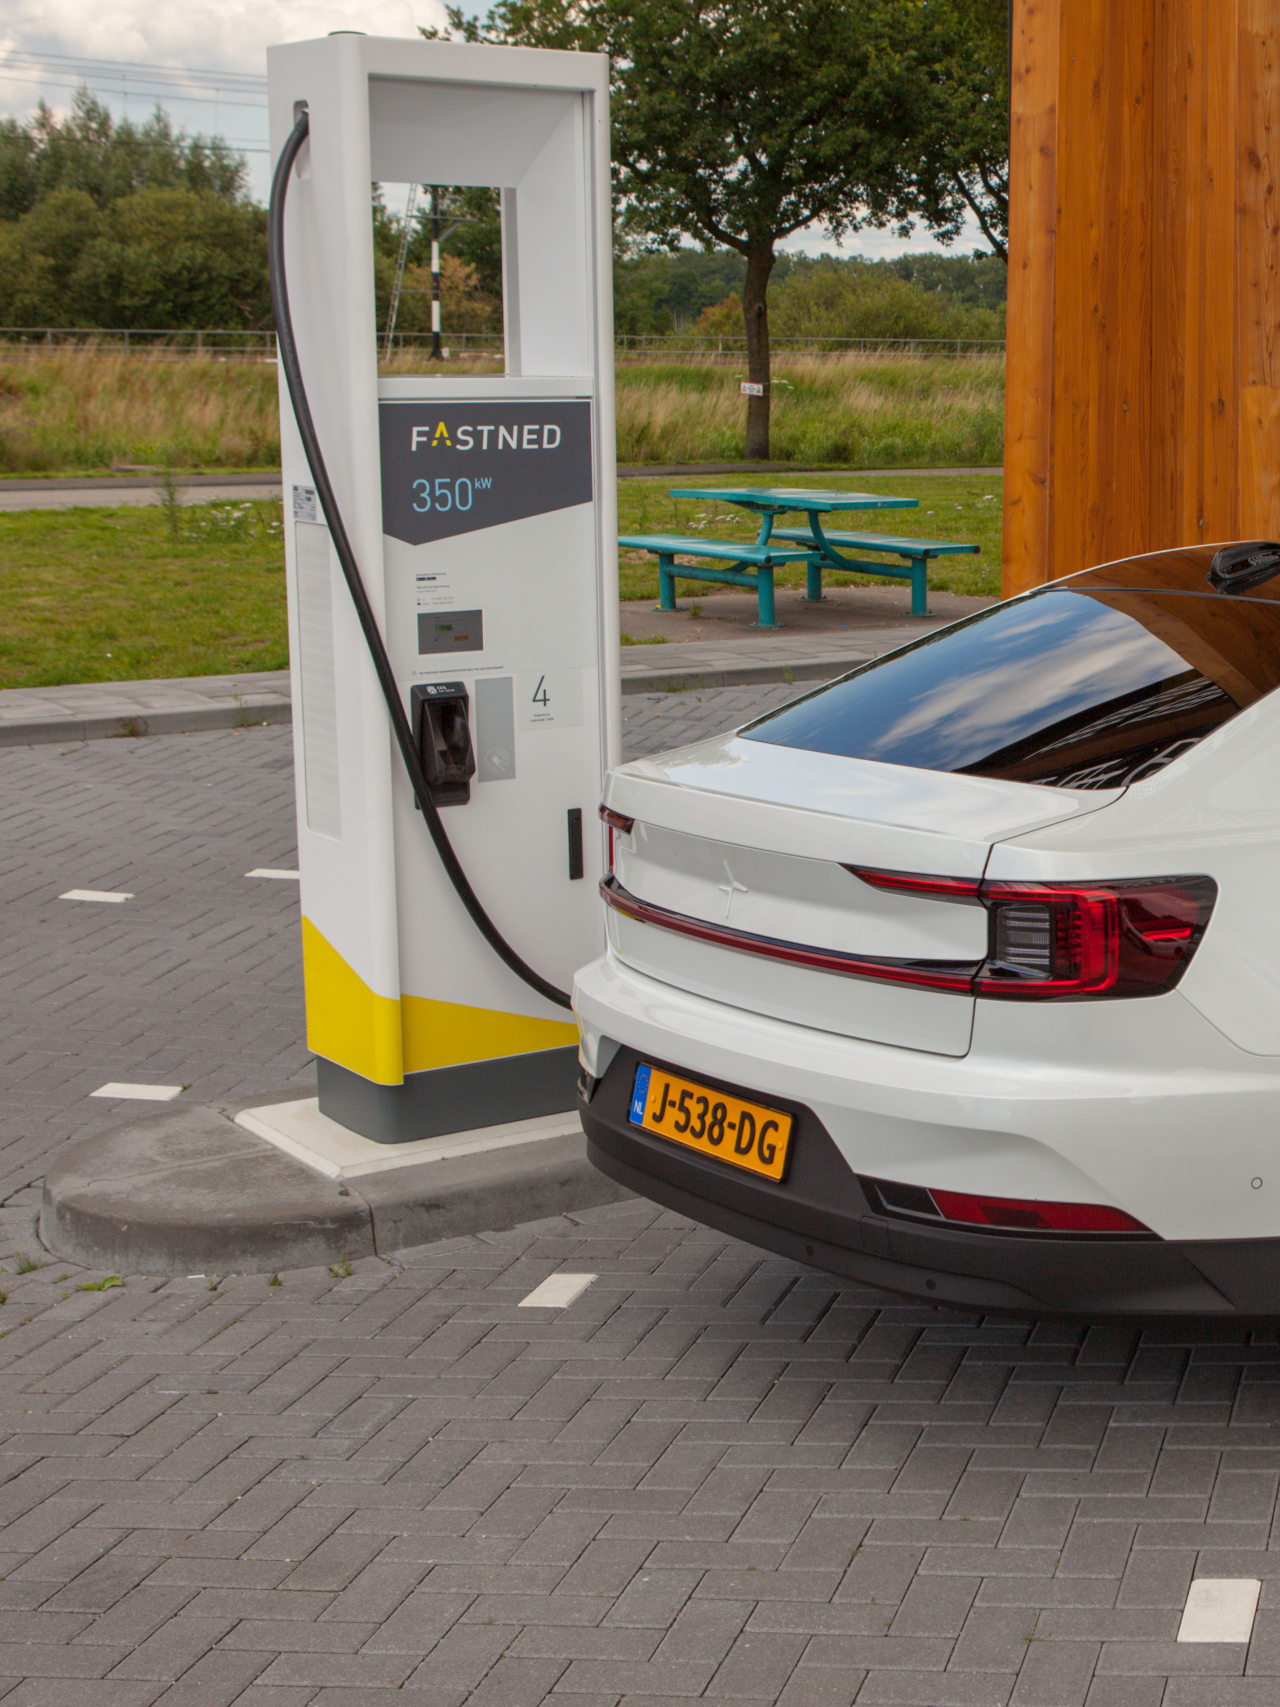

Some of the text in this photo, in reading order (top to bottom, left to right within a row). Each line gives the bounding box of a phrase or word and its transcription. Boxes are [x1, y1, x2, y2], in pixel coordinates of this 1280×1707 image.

[411, 421, 562, 451] FASTNED
[532, 675, 550, 707] 4
[633, 1100, 644, 1115] NL
[652, 1083, 780, 1165] J-538-DG
